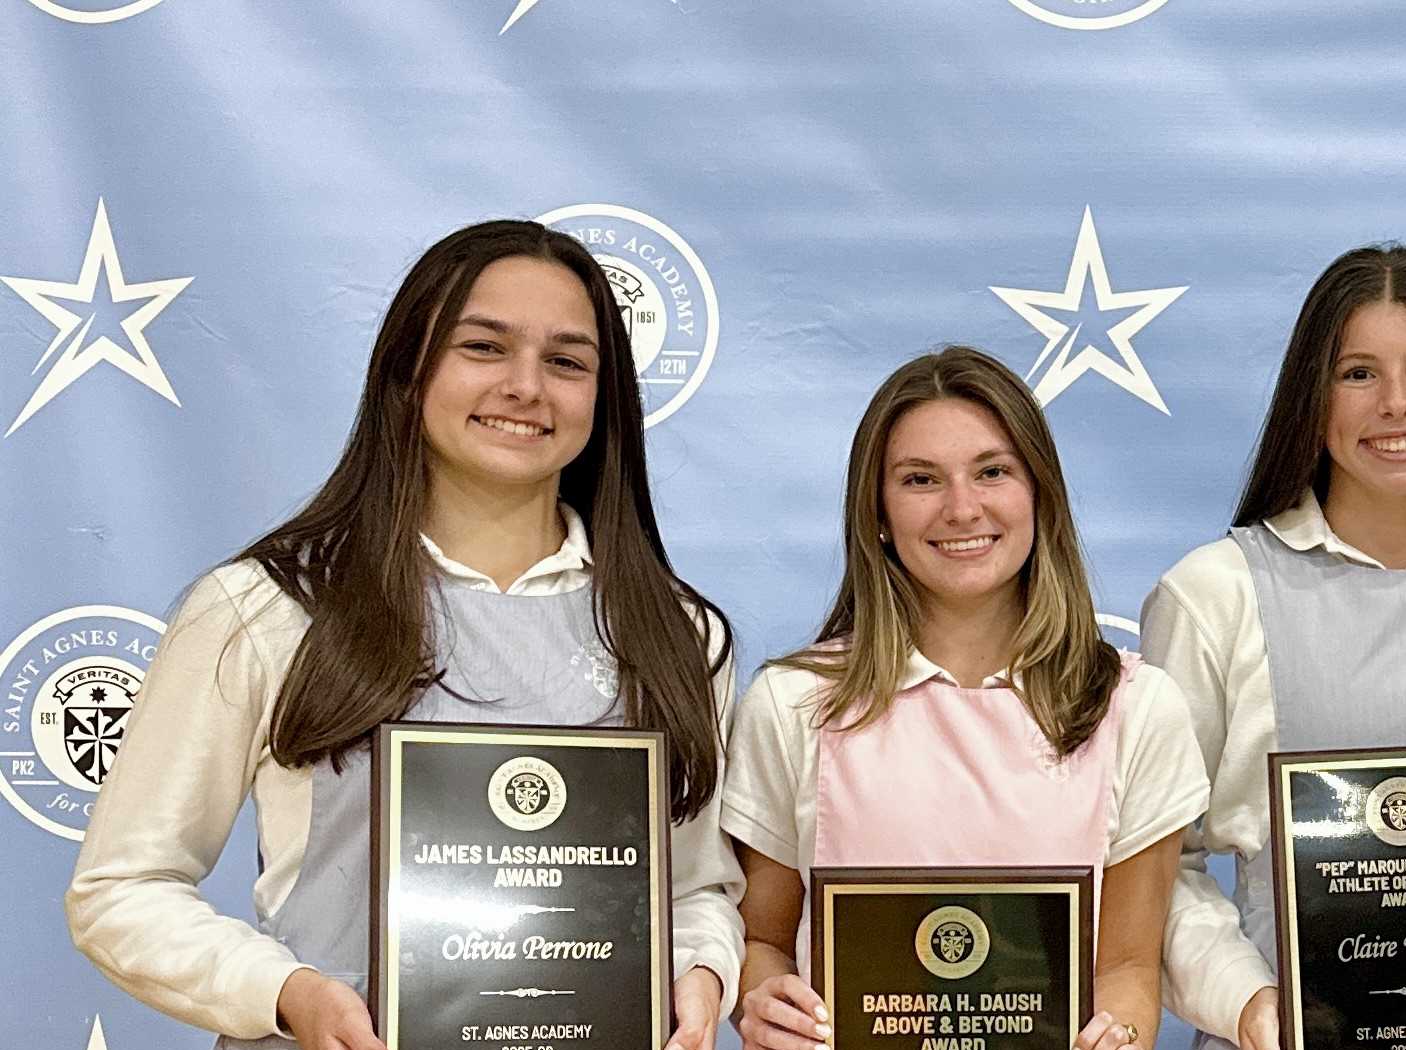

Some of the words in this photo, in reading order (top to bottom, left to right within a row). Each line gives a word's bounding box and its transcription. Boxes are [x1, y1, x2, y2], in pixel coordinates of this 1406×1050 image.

[622, 236, 694, 337] ACADEMY
[636, 311, 656, 324] 1851
[659, 359, 687, 375] 12TH
[3, 659, 41, 734] SAINT
[42, 630, 119, 665] AGNES
[67, 670, 131, 687] VERITAS
[12, 760, 35, 776] PK2
[46, 793, 81, 815] for
[414, 844, 482, 865] JAMES
[487, 845, 637, 866] LASSANDRELLO
[494, 868, 562, 888] AWARD
[1329, 876, 1390, 894] ATHLETE
[441, 932, 517, 961] Olivia
[521, 934, 613, 961] Perrone
[1338, 934, 1398, 963] Claire
[863, 994, 952, 1013] BARBARA
[956, 994, 975, 1013] H.
[980, 993, 1042, 1012] DAUSH
[461, 1026, 482, 1041] ST.
[484, 1026, 529, 1041] AGNES
[531, 1024, 593, 1040] ACADEMY
[872, 1016, 935, 1035] ABOVE
[939, 1016, 954, 1034] &
[958, 1015, 1033, 1034] BEYOND
[1356, 1027, 1374, 1041] ST.
